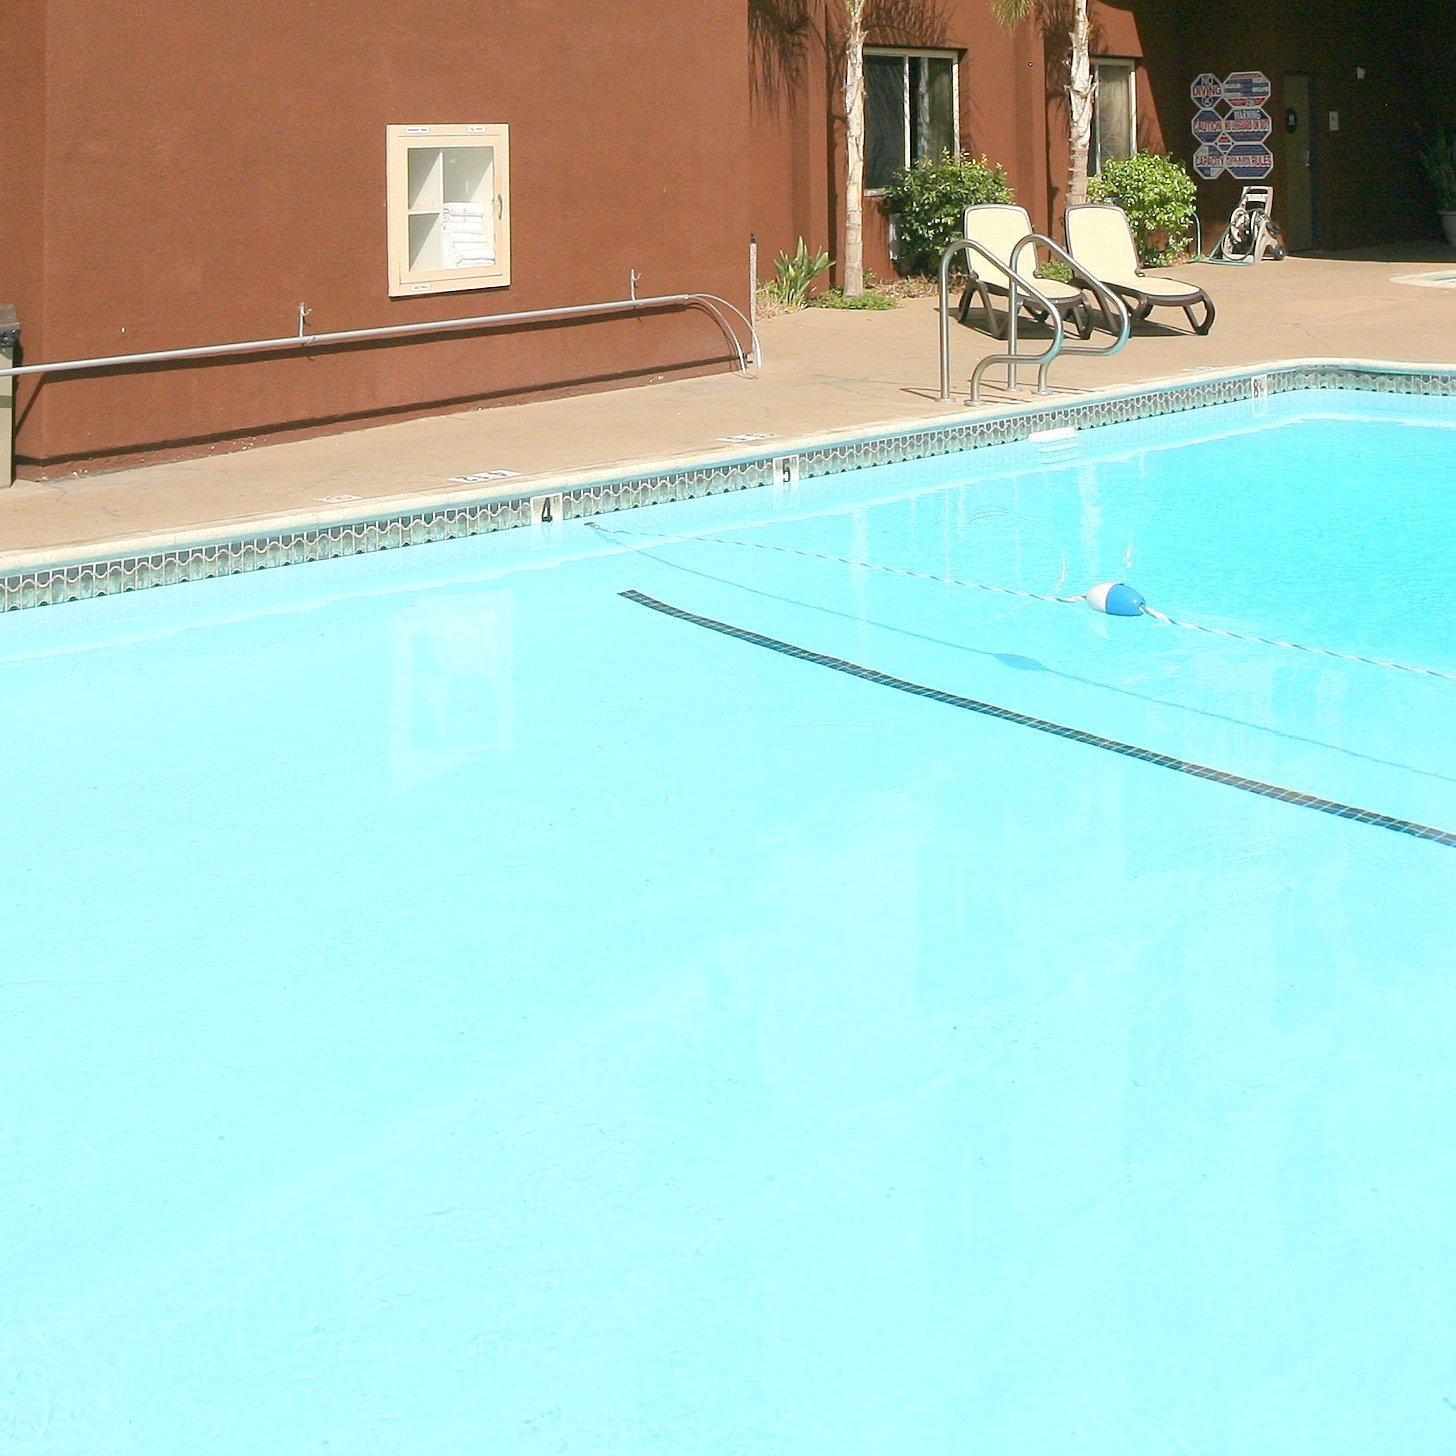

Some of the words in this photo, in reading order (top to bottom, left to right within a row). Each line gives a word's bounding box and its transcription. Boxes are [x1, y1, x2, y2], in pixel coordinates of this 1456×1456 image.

[1193, 85, 1222, 95] DIVING
[1194, 121, 1223, 132] CAUTION
[1195, 156, 1224, 166] CAPACITY
[1251, 156, 1271, 166] RULES
[782, 458, 791, 483] 5
[541, 497, 553, 522] 4
